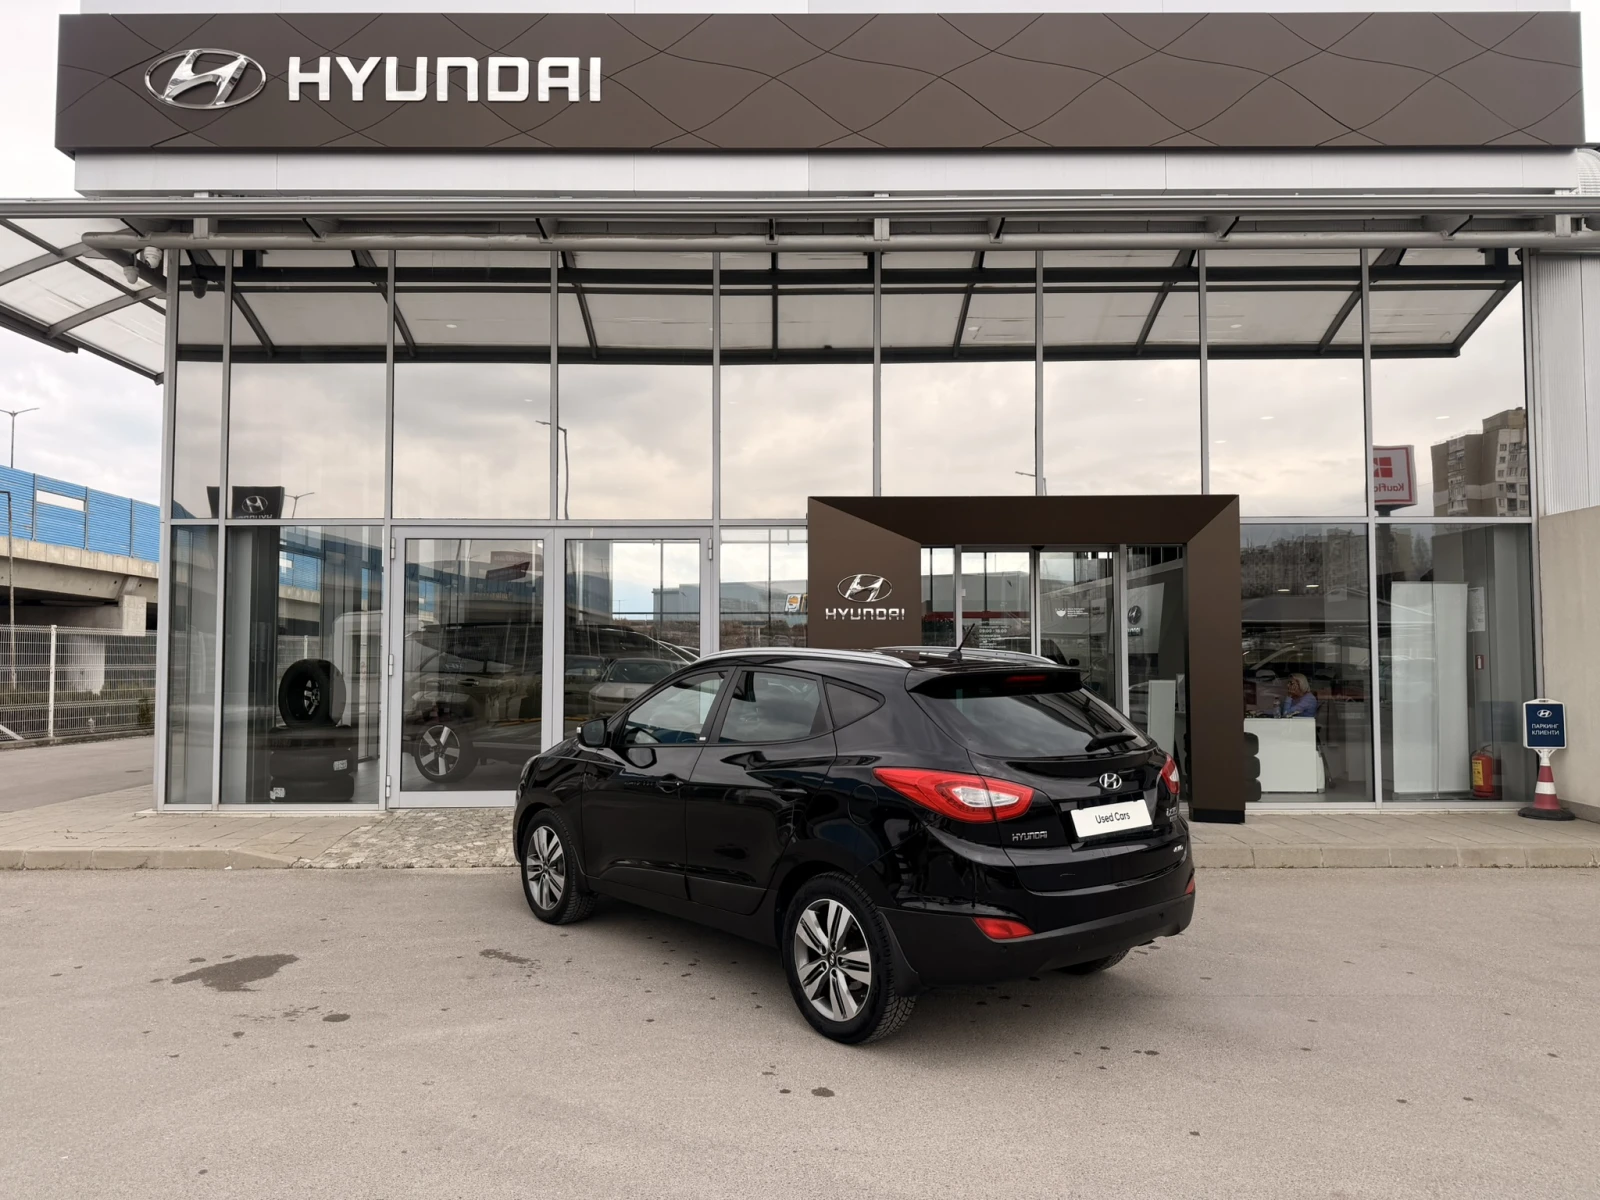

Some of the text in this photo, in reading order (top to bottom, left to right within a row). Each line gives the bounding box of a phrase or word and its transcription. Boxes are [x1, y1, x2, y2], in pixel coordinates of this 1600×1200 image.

[288, 56, 602, 102] HYUNDAI
[825, 608, 905, 620] HYUNDAI
[1095, 812, 1131, 824] Used Cars
[1011, 830, 1048, 841] HYUNDAI
